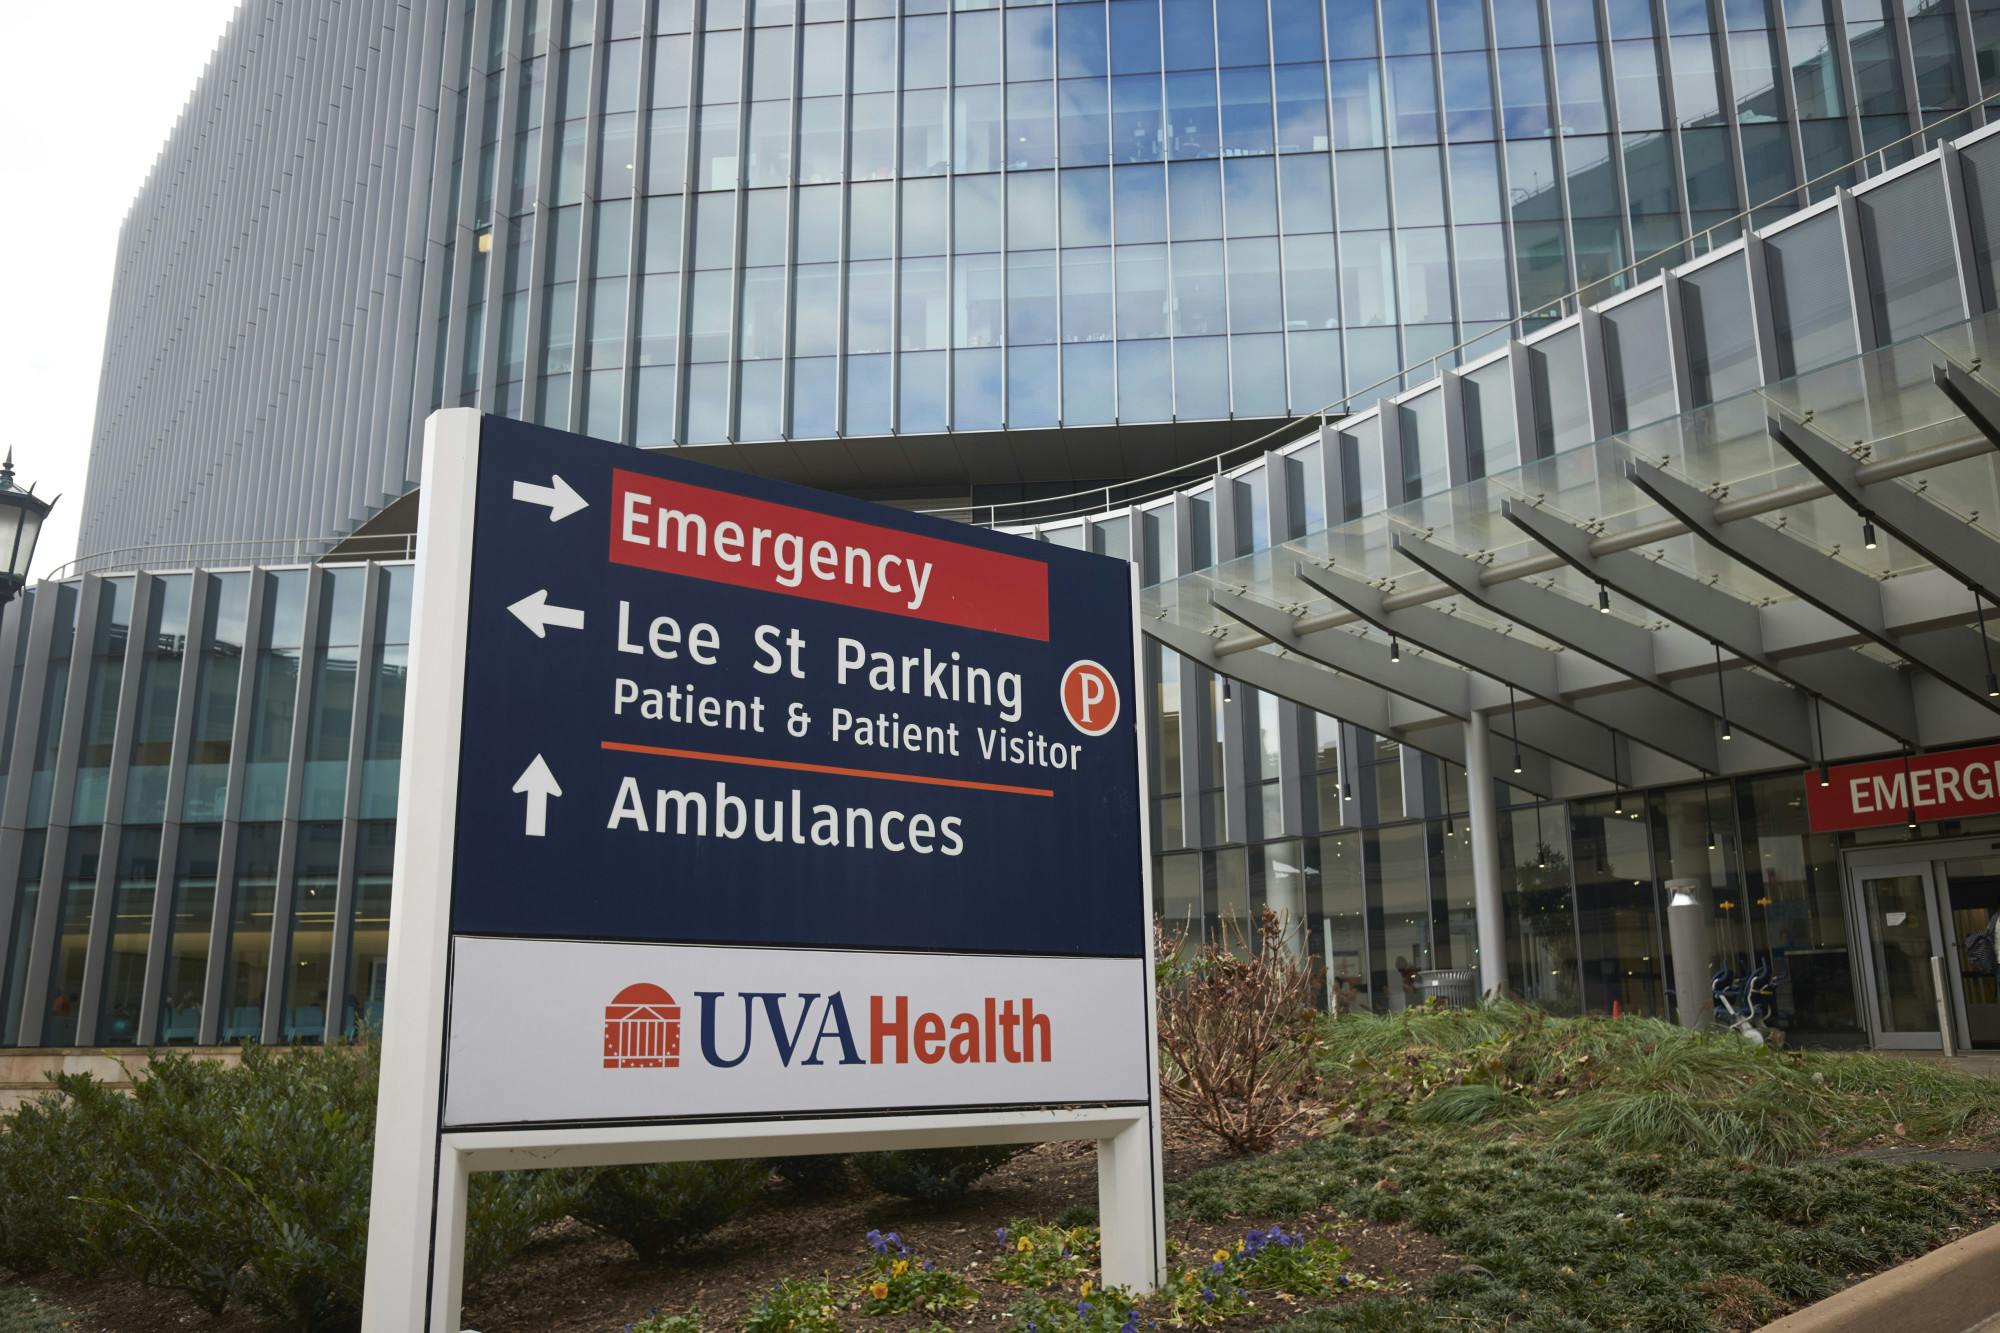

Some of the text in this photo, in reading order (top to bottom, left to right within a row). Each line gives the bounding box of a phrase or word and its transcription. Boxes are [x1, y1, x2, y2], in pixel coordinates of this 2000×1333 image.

[622, 491, 934, 610] Emergency
[617, 600, 1023, 723] Lee St Parking
[1080, 672, 1105, 724] P
[614, 678, 1083, 771] Patient & Patient Visitor
[606, 776, 966, 856] Ambulances
[1849, 760, 2000, 815] EMERG
